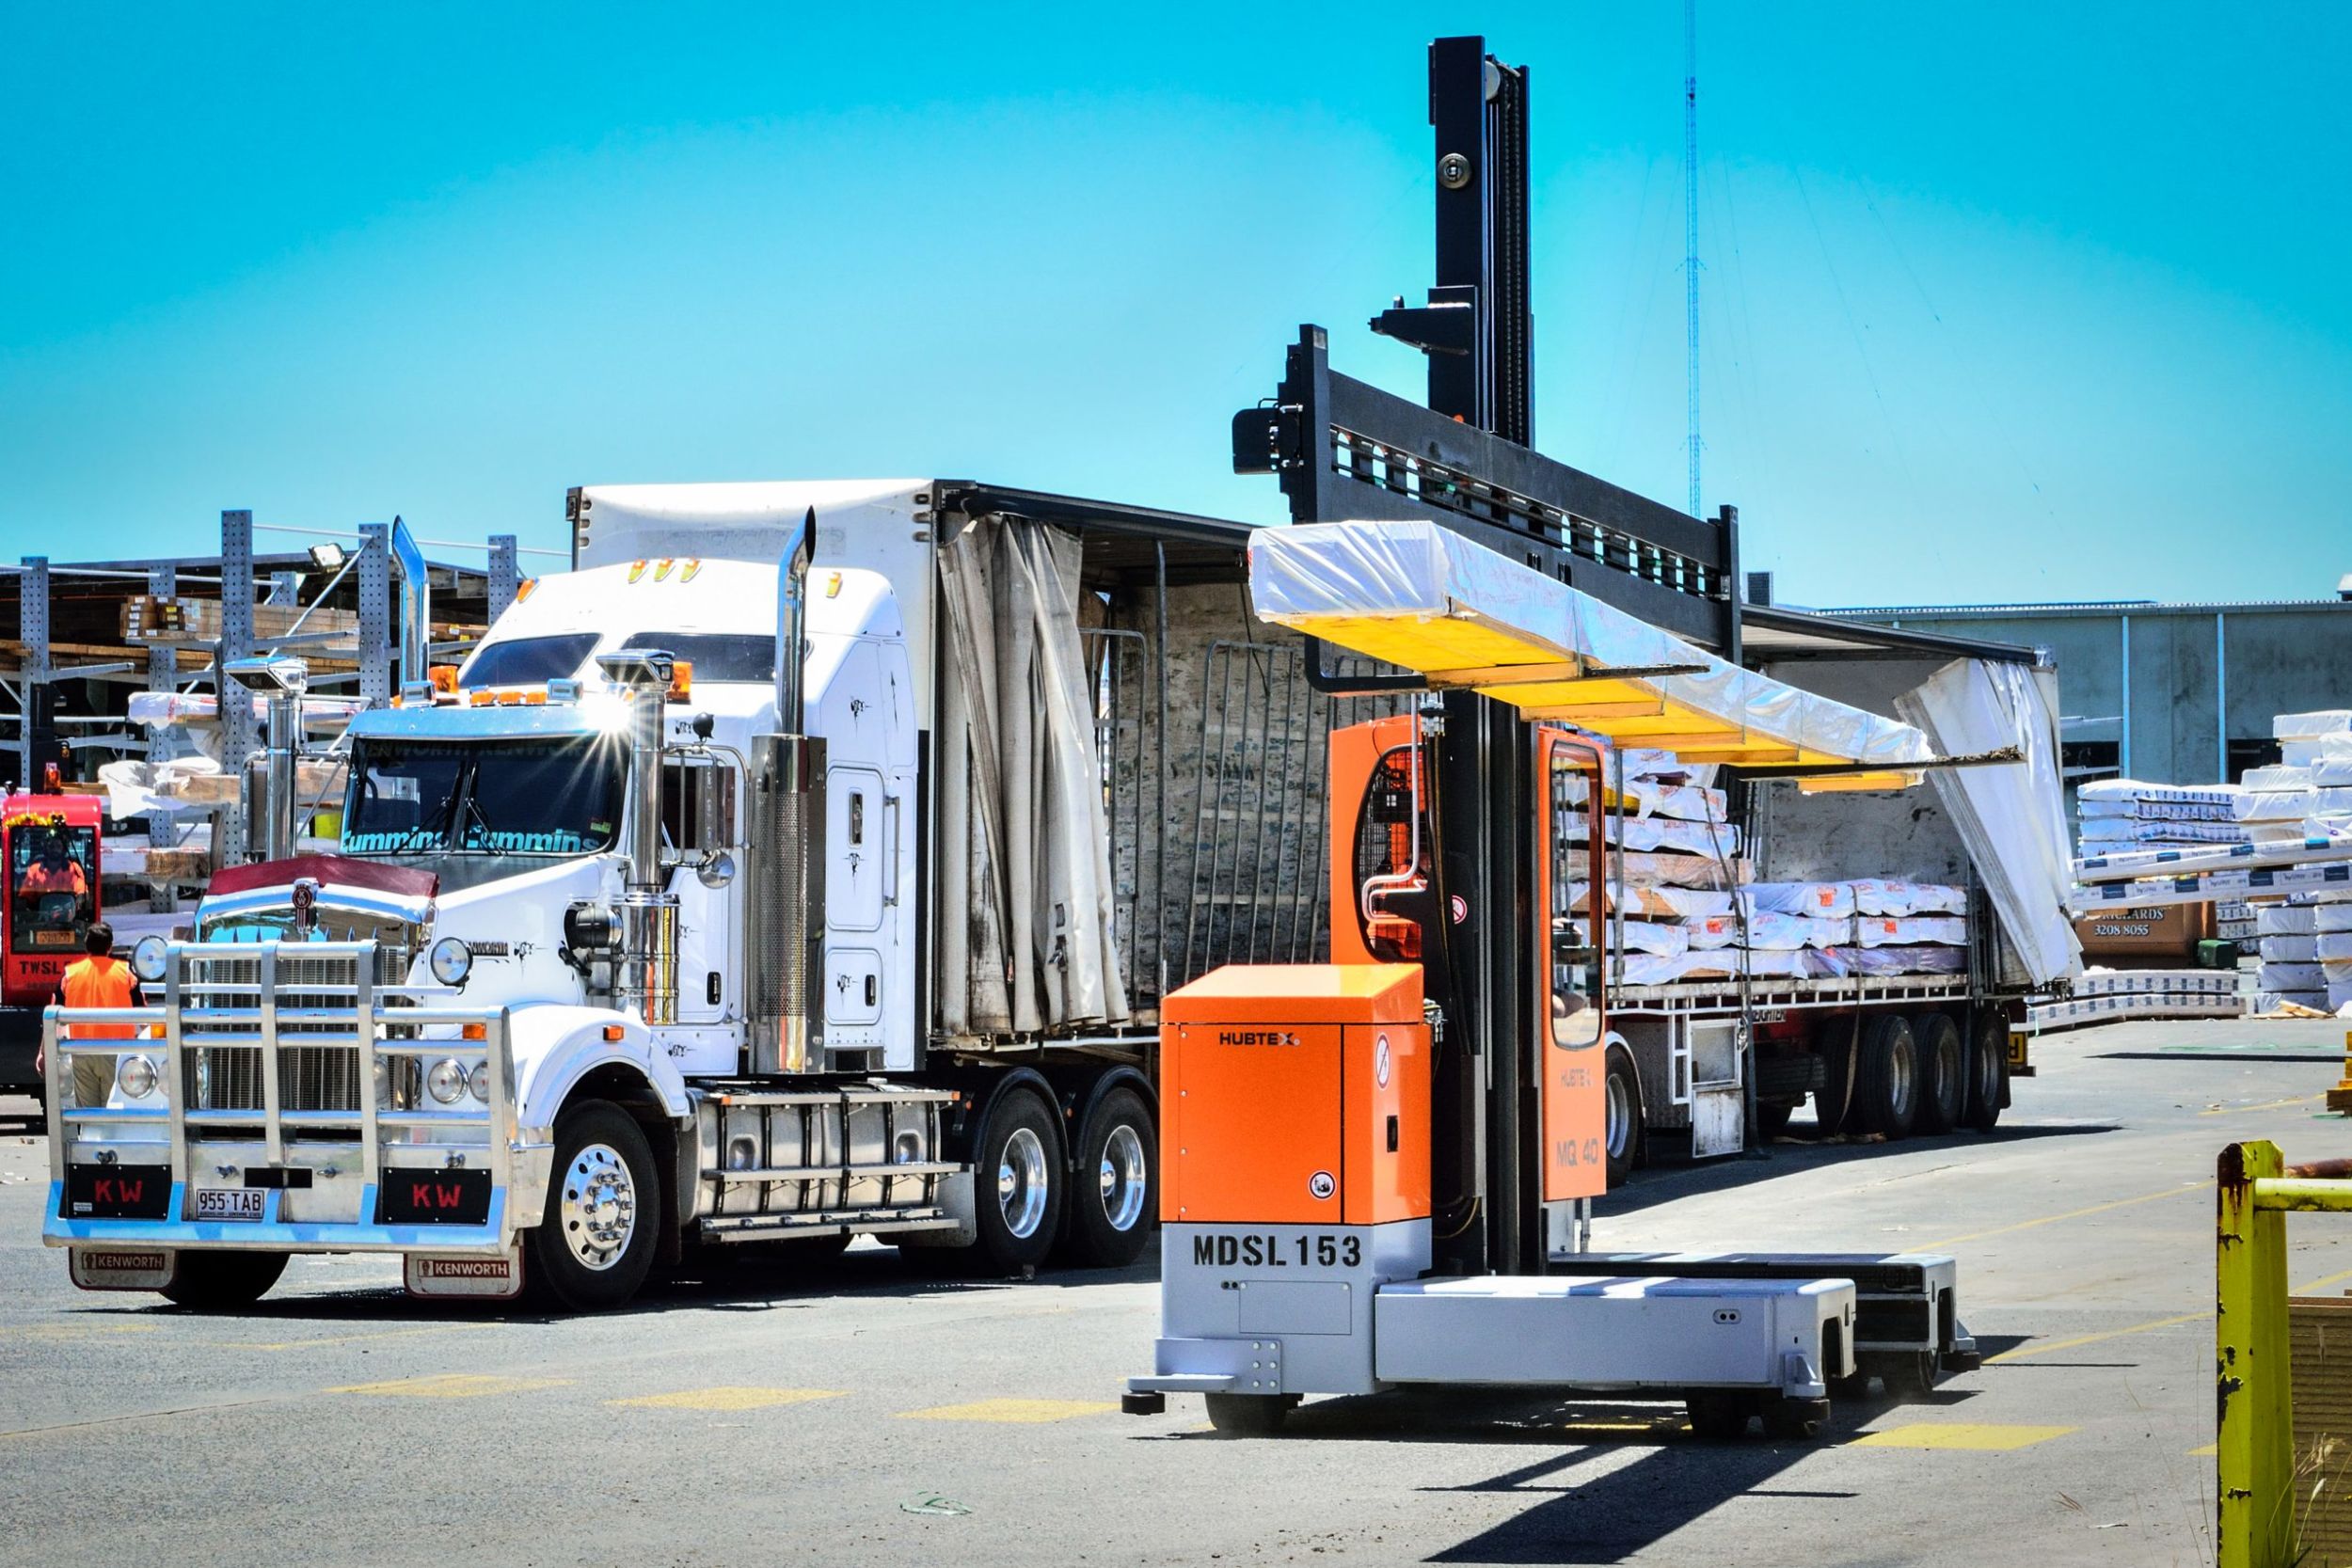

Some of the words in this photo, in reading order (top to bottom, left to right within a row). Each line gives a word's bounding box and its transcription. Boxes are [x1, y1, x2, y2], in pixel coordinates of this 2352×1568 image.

[2094, 925, 2121, 935] 3208
[470, 942, 508, 954] NWORTH
[1219, 1032, 1294, 1046] HUBTEX
[1557, 1140, 1577, 1166] MQ
[1583, 1138, 1598, 1164] 40
[98, 1256, 163, 1267] KENWORTH
[436, 1263, 507, 1275] KENWORTH
